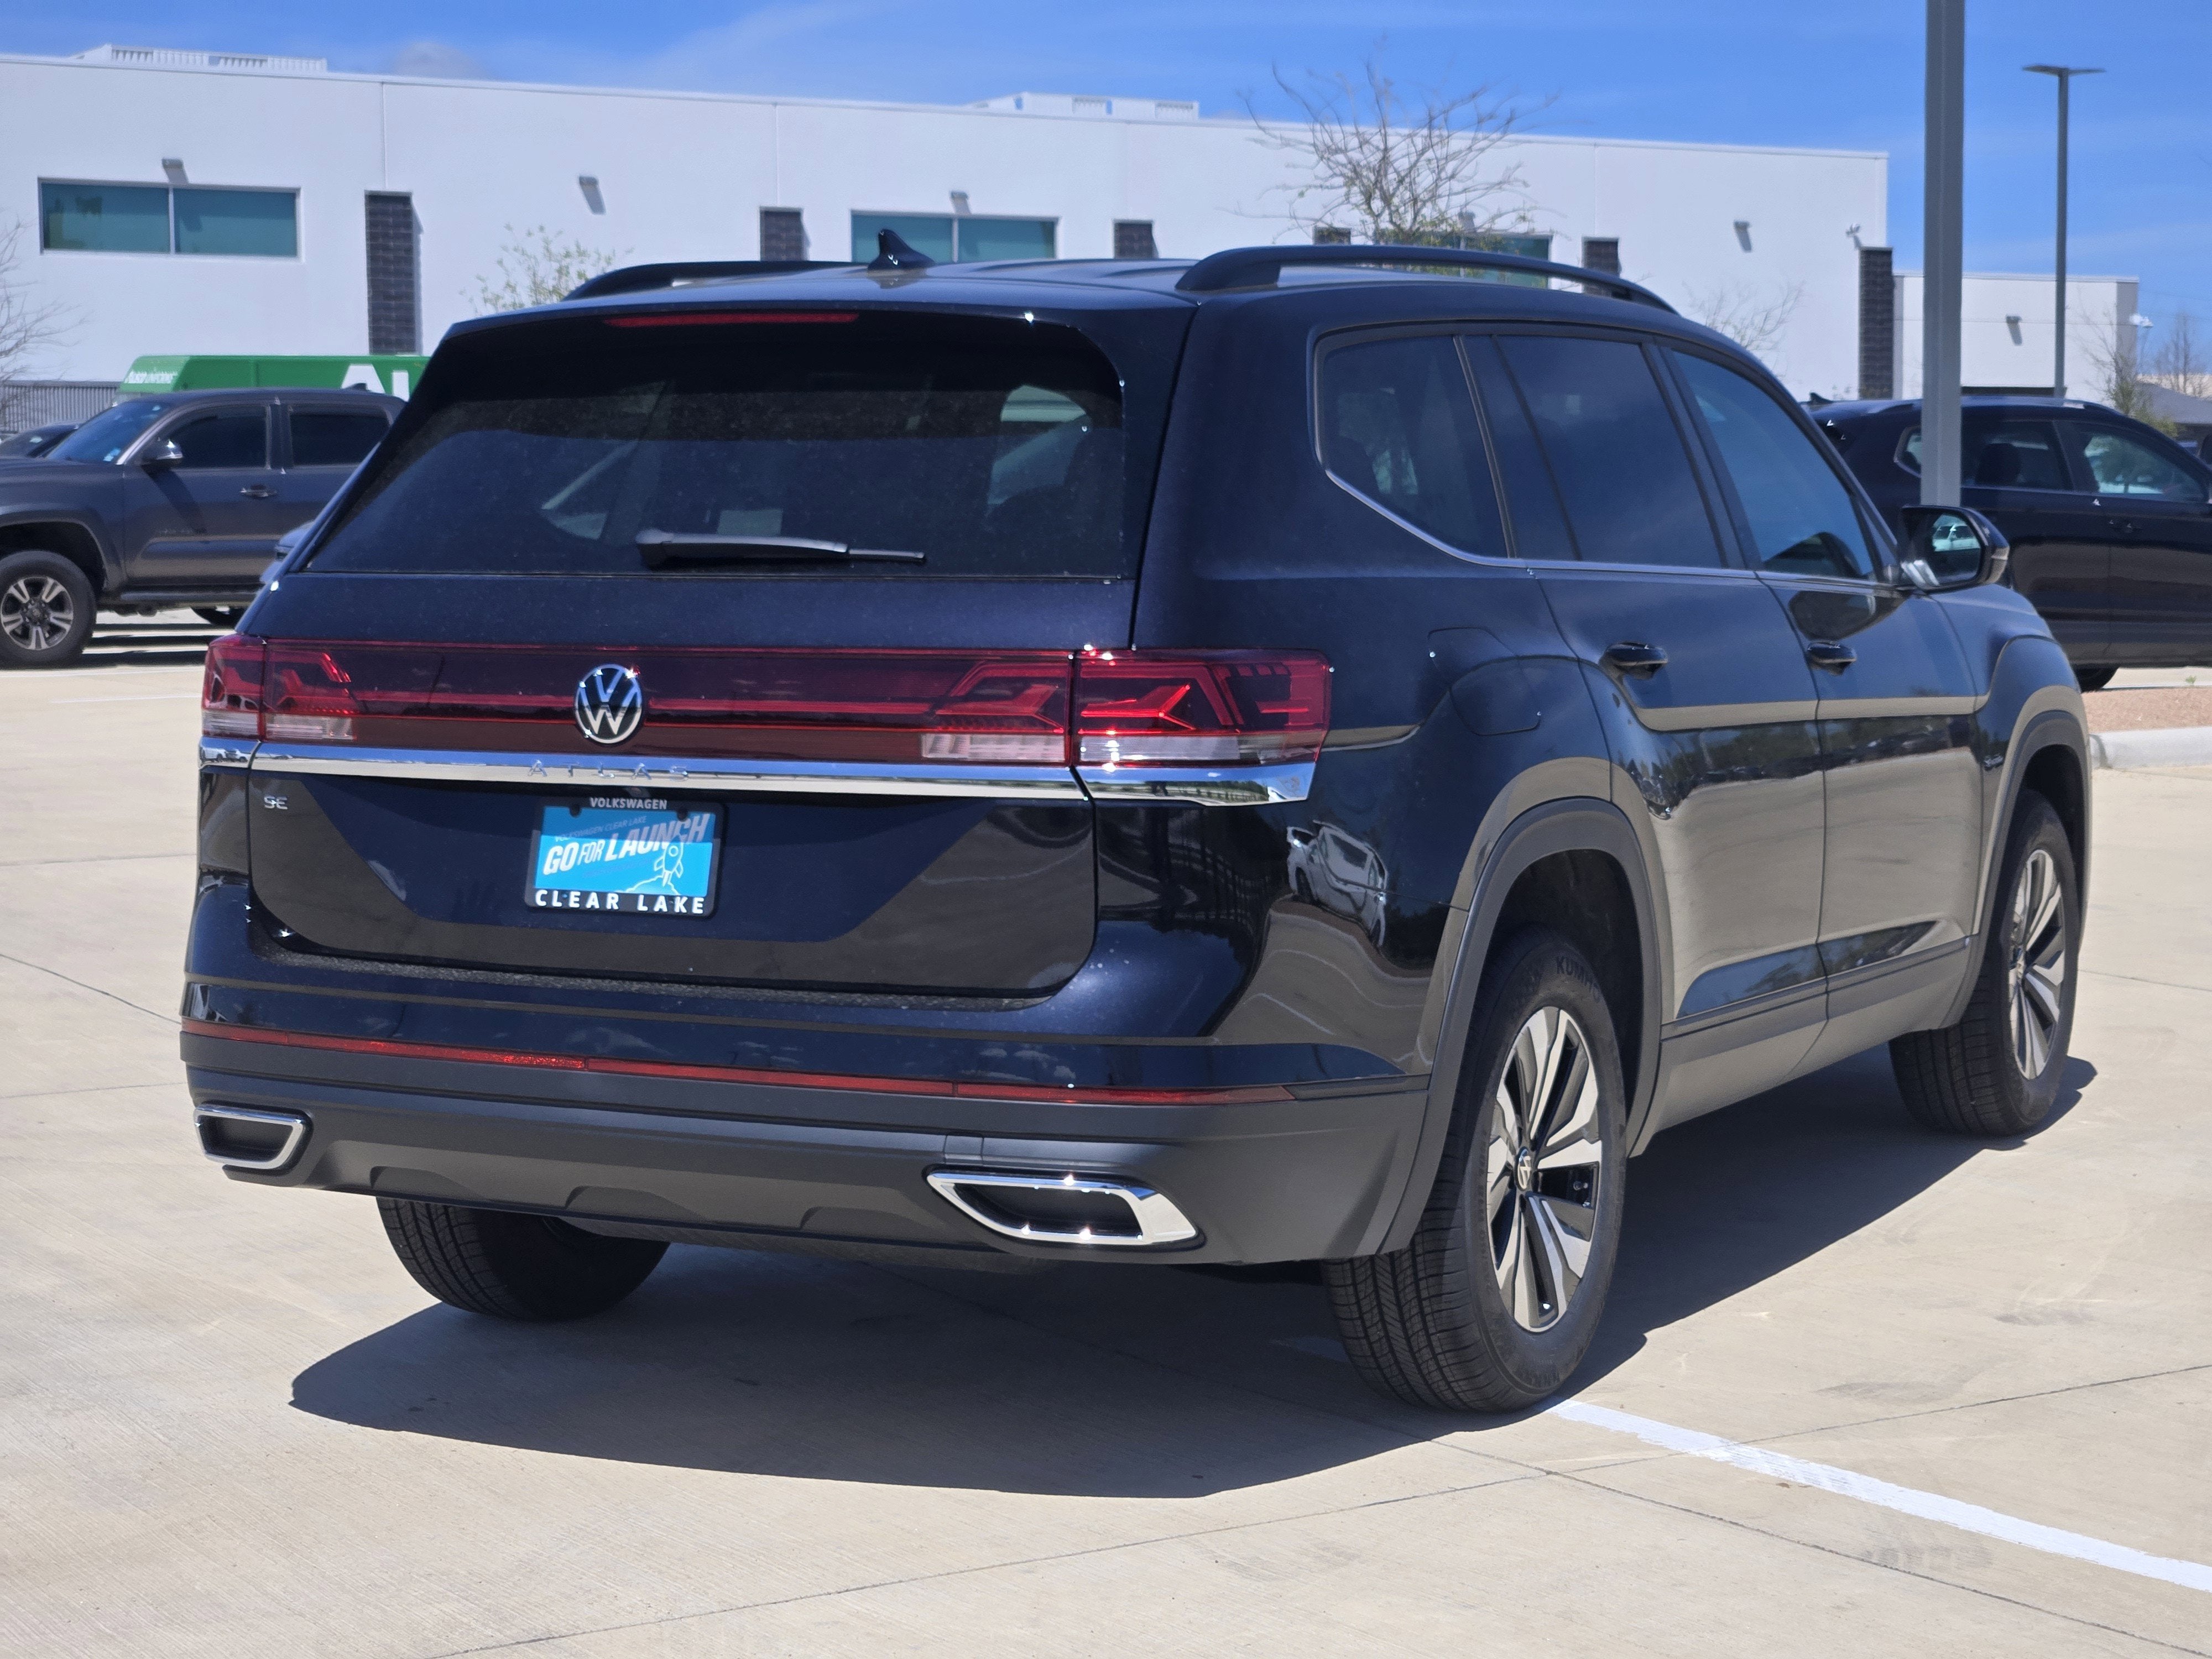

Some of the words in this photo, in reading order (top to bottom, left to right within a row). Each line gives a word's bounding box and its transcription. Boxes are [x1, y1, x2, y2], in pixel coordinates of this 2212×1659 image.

[575, 664, 642, 743] VW
[527, 759, 688, 781] ATLAS
[264, 795, 288, 810] SE
[589, 797, 667, 810] VOLKSWAGEN
[543, 842, 580, 875] GO
[577, 839, 607, 866] FOR
[604, 813, 711, 862] LAUNCH
[535, 889, 619, 910] CLEAR
[637, 894, 705, 914] LAKE
